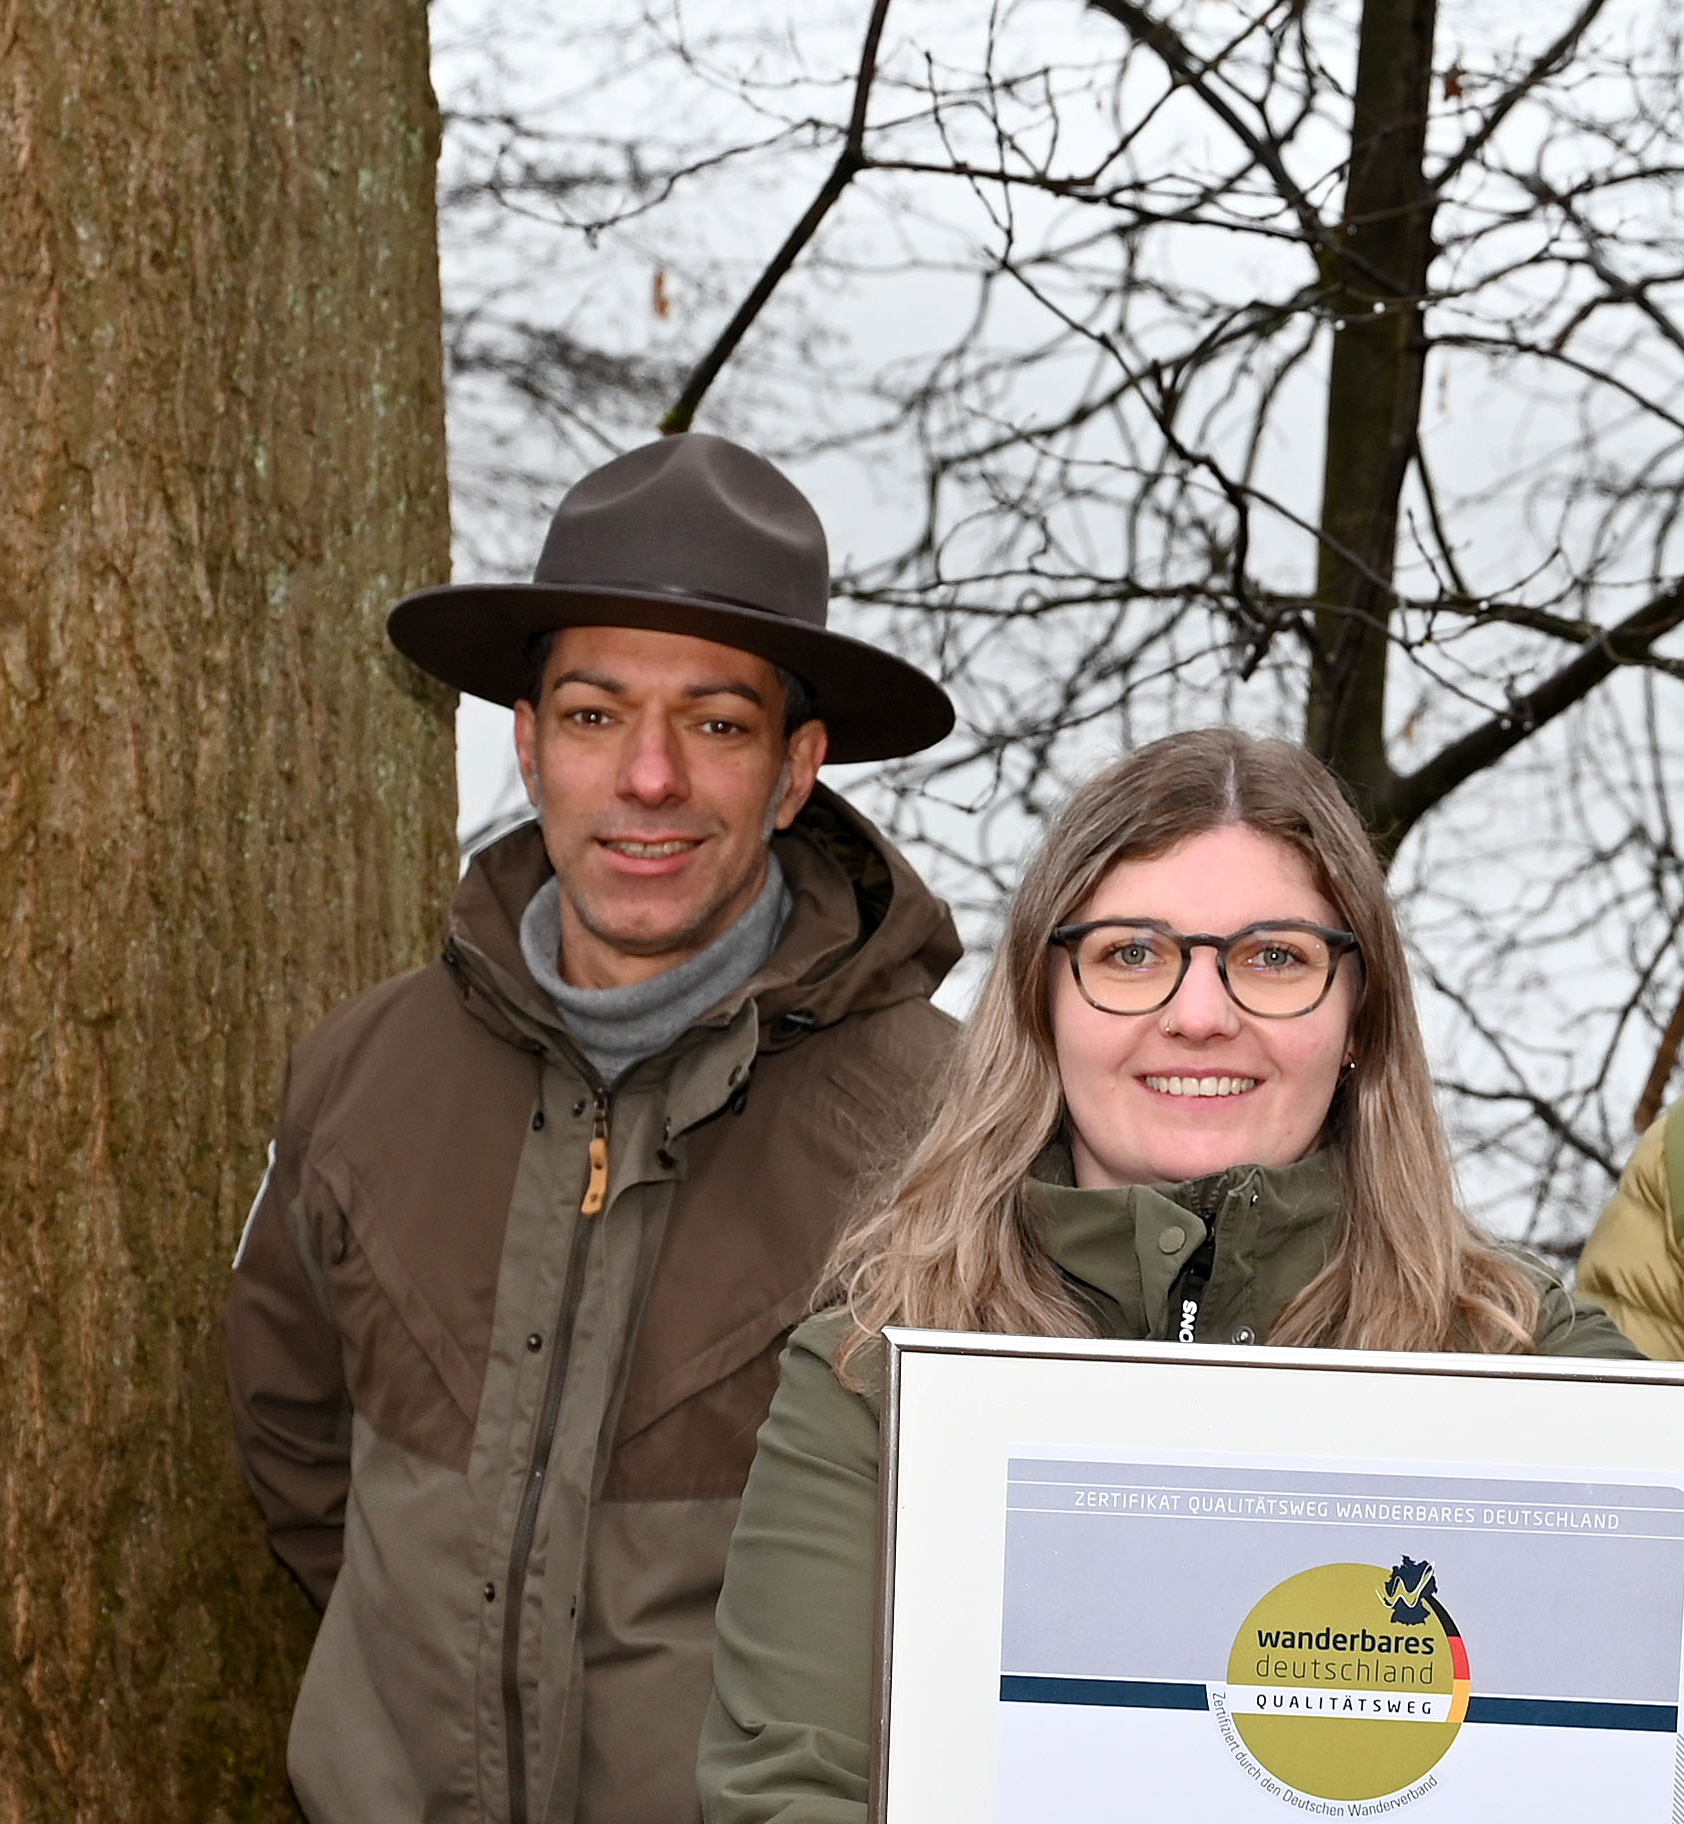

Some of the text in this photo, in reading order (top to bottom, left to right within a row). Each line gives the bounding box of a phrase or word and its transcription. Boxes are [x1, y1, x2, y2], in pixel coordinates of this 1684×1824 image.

[1074, 1491, 1619, 1530] ZERTIFIKAT QUALITÄTSWEG WANDERBARES DEUTSCHLAND
[1256, 1627, 1436, 1656] wanderbares
[1254, 1655, 1435, 1685] deutschland
[1256, 1693, 1433, 1715] QUALITÄTSWEG
[1212, 1691, 1439, 1817] Zertifiziert durch den Deutschen Wanderverband
